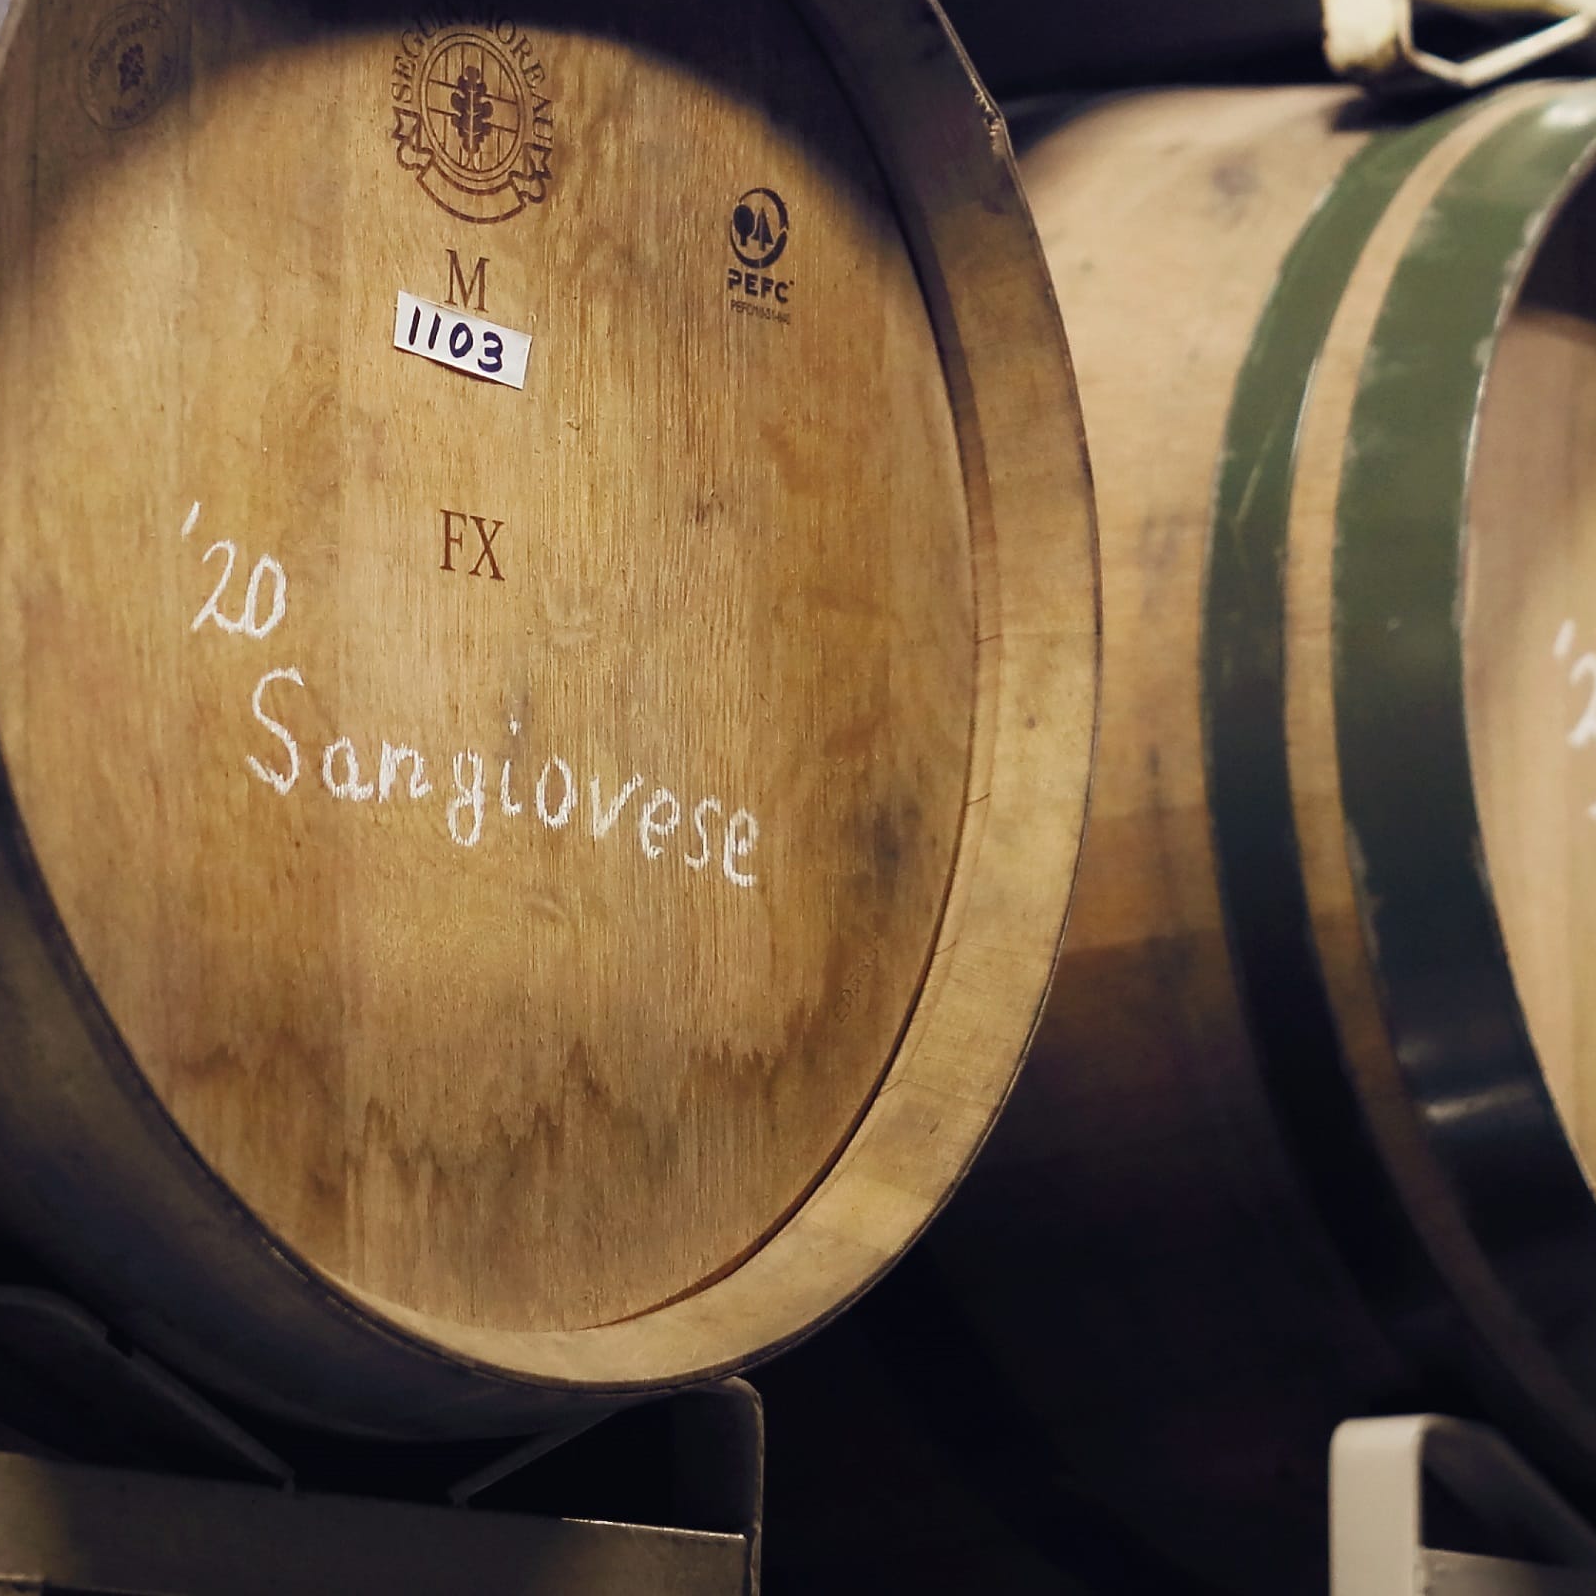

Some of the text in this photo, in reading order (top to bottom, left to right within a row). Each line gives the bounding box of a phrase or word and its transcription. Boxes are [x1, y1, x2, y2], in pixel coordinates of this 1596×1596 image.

[473, 1, 553, 141] MOREAU
[444, 248, 491, 313] M
[727, 267, 789, 304] PEFC
[408, 305, 504, 373] 1103
[181, 501, 288, 639] '20
[439, 508, 505, 581] FX
[245, 665, 760, 888] Sangiovese
